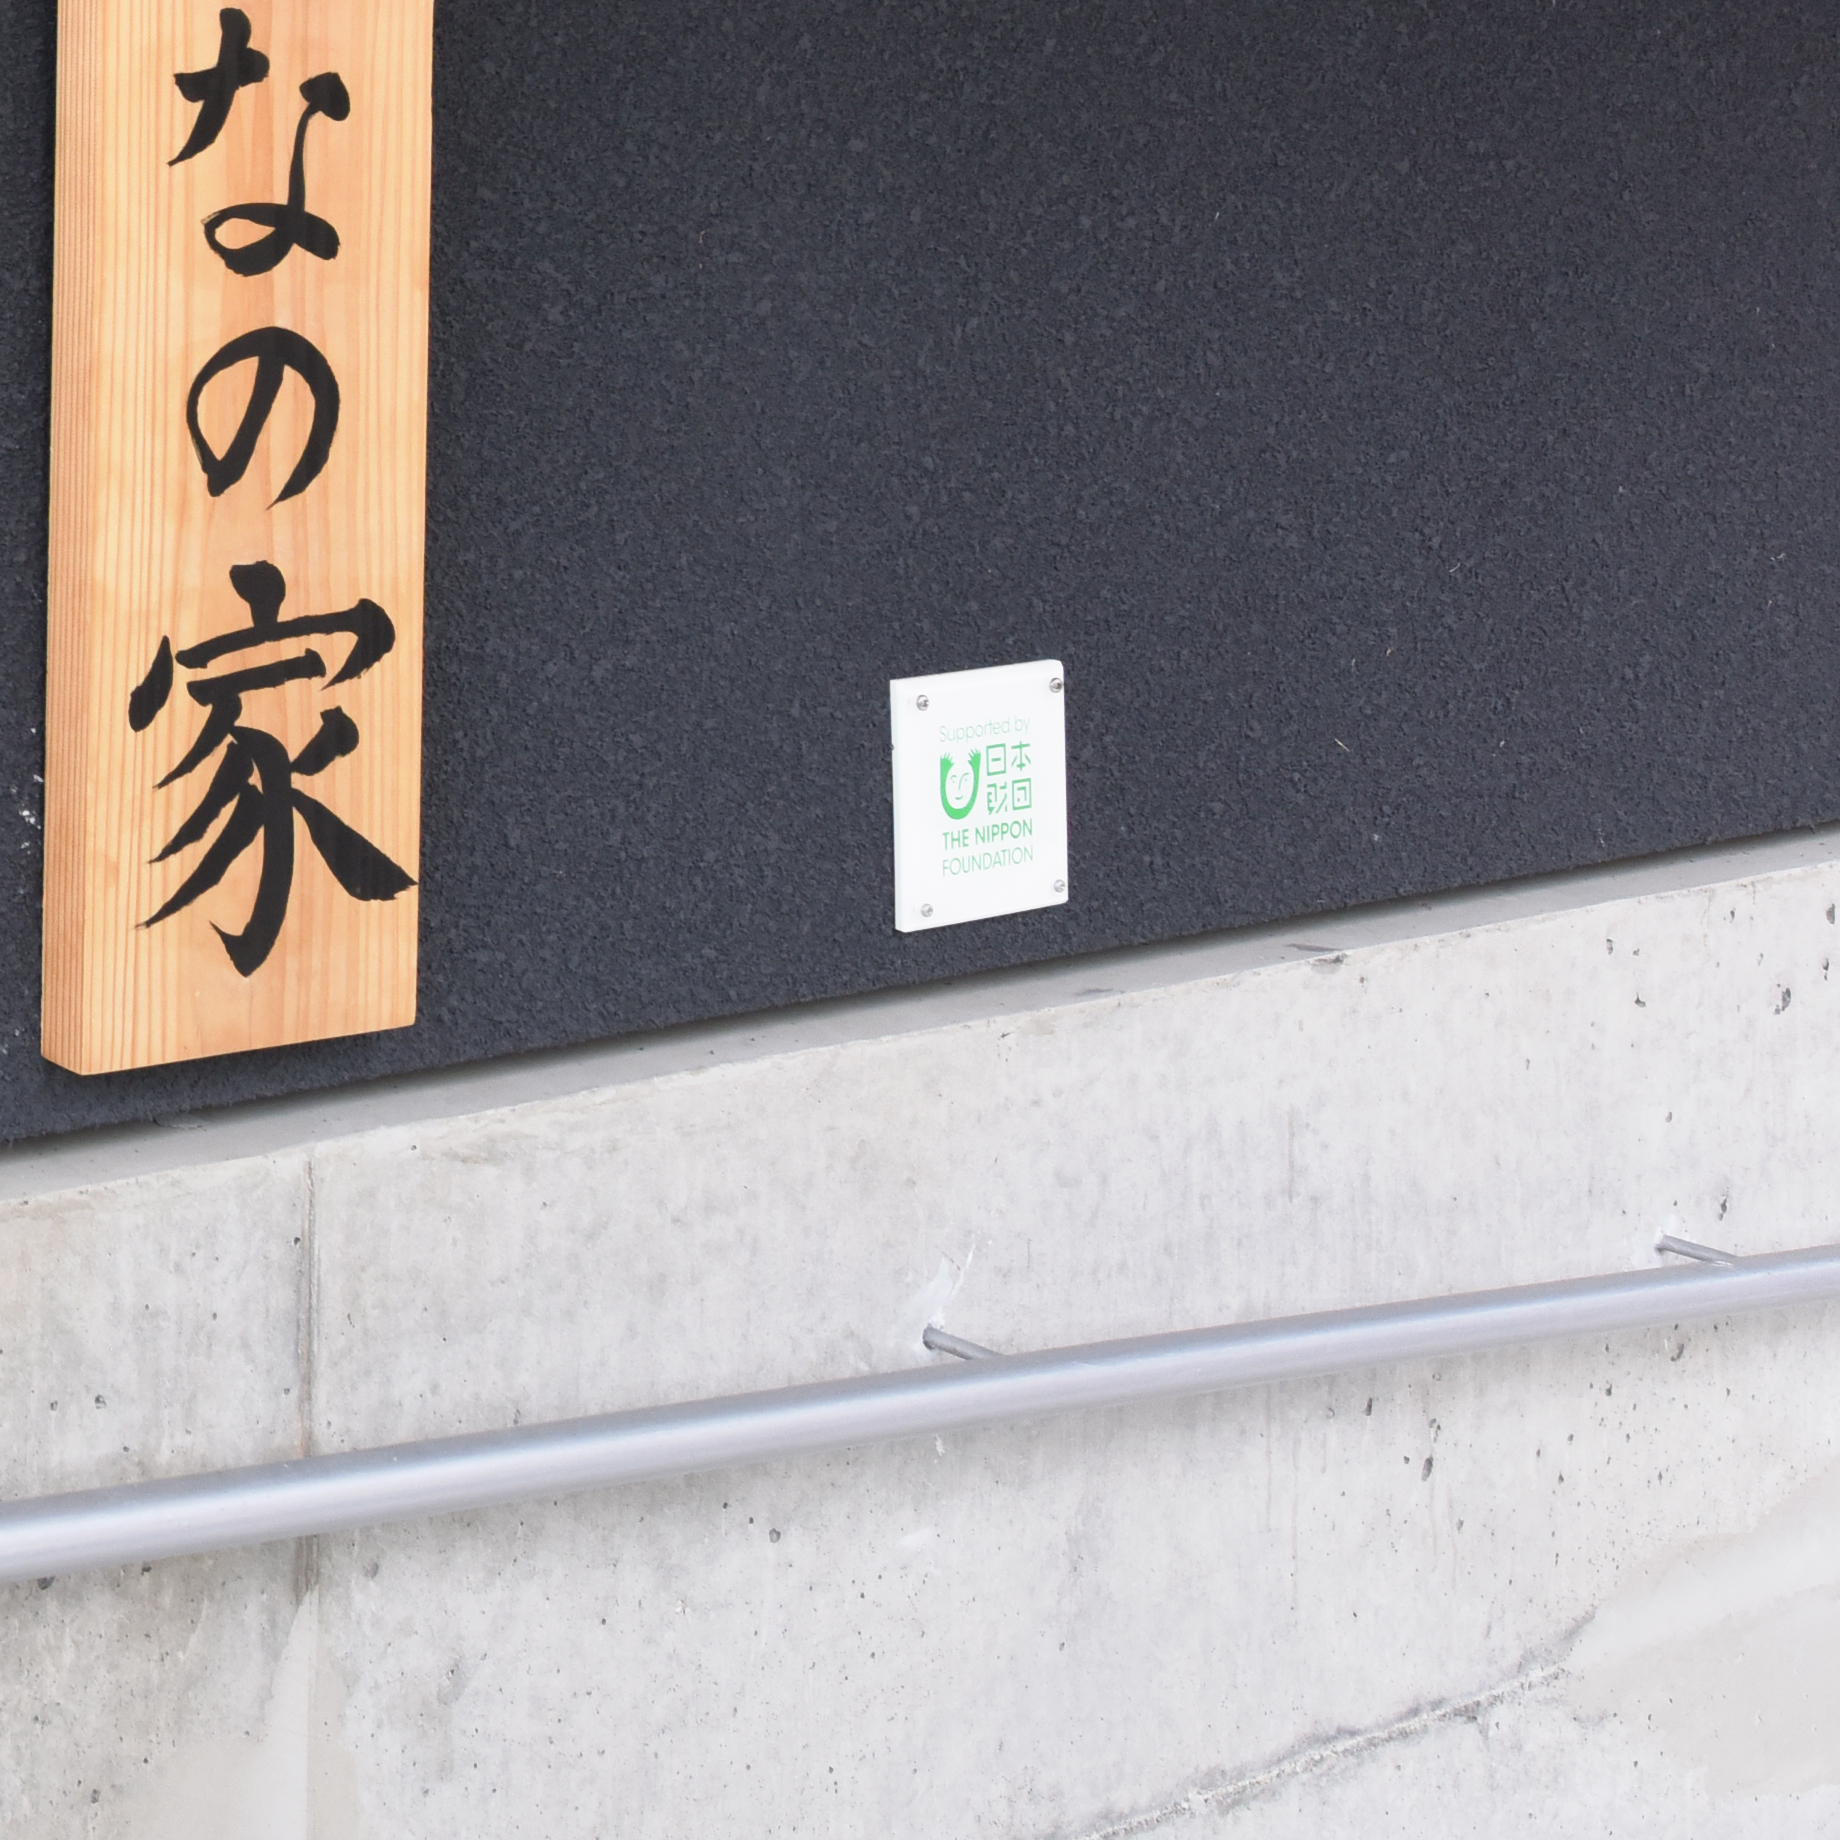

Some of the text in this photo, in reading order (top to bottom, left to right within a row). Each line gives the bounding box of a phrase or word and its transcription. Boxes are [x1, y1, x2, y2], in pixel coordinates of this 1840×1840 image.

[939, 715, 1030, 744] Supported by
[985, 740, 1032, 777] 日本
[986, 777, 1032, 816] 財団
[942, 818, 1033, 851] THE NIPPON
[942, 844, 1033, 877] FOUNDATION
